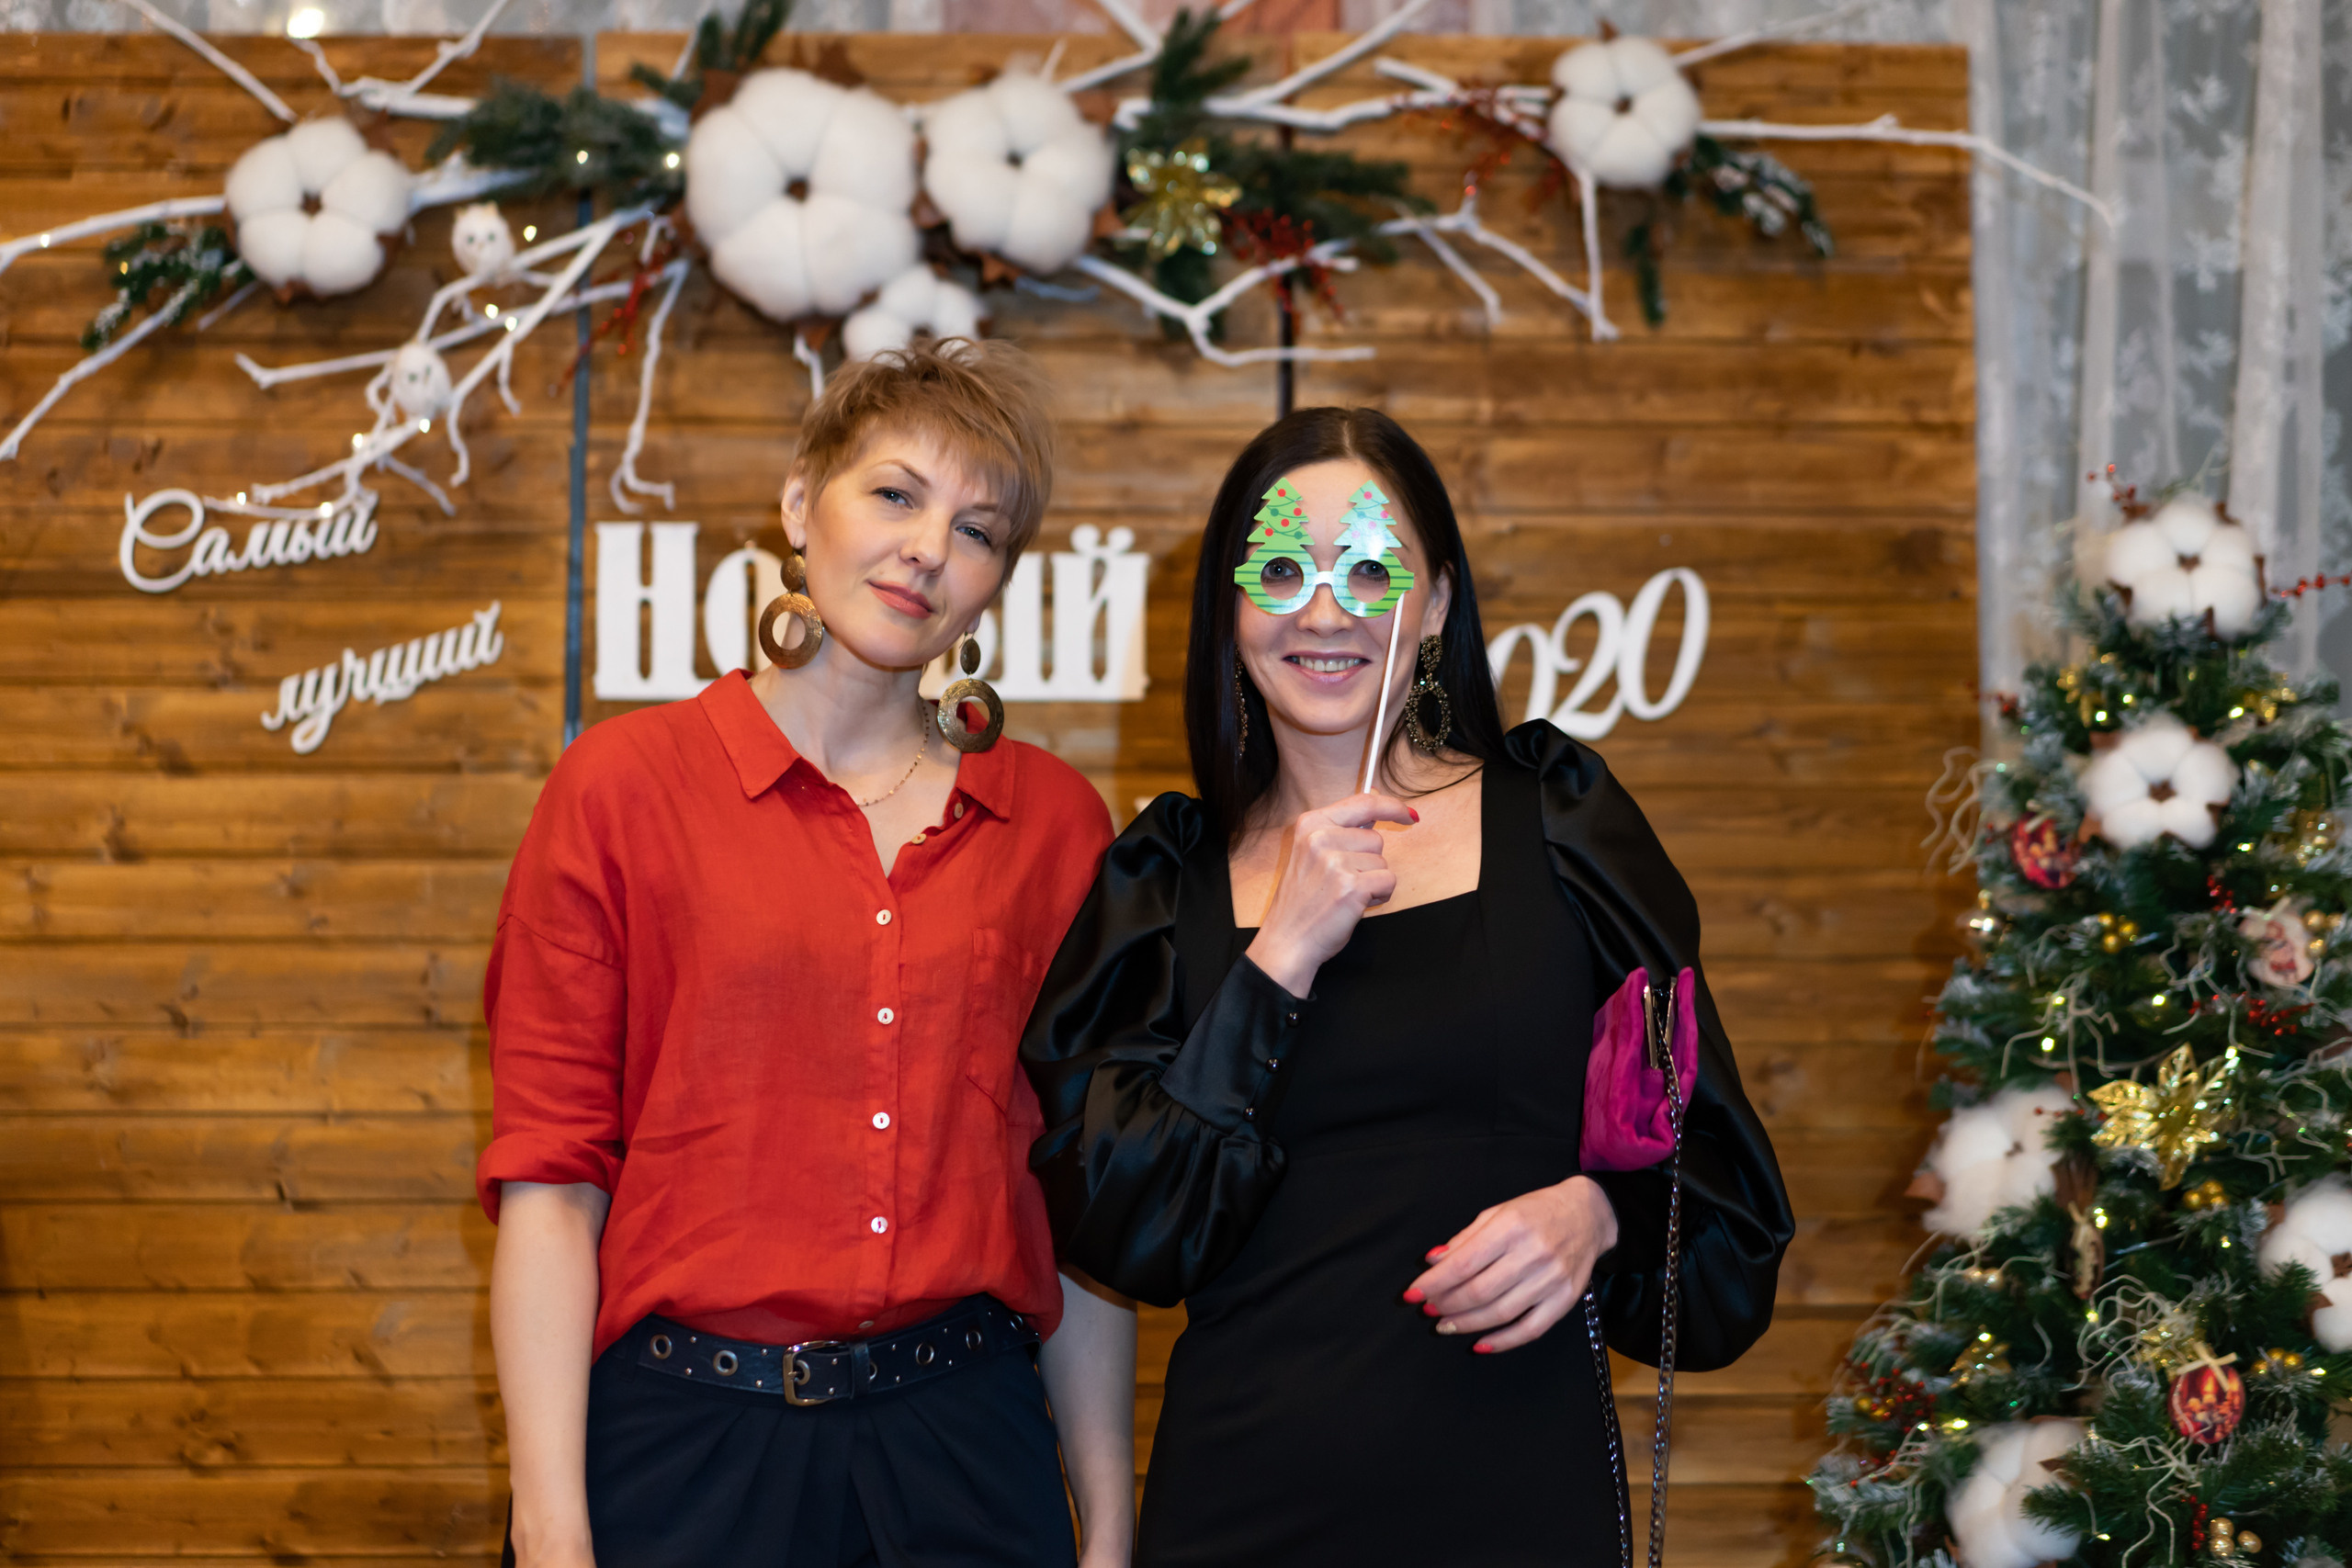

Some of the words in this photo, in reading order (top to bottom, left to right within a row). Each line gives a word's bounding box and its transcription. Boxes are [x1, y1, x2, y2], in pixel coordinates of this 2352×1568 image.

[119, 488, 379, 593] Самый
[261, 599, 504, 754] лучший
[1487, 566, 1711, 740] 020
